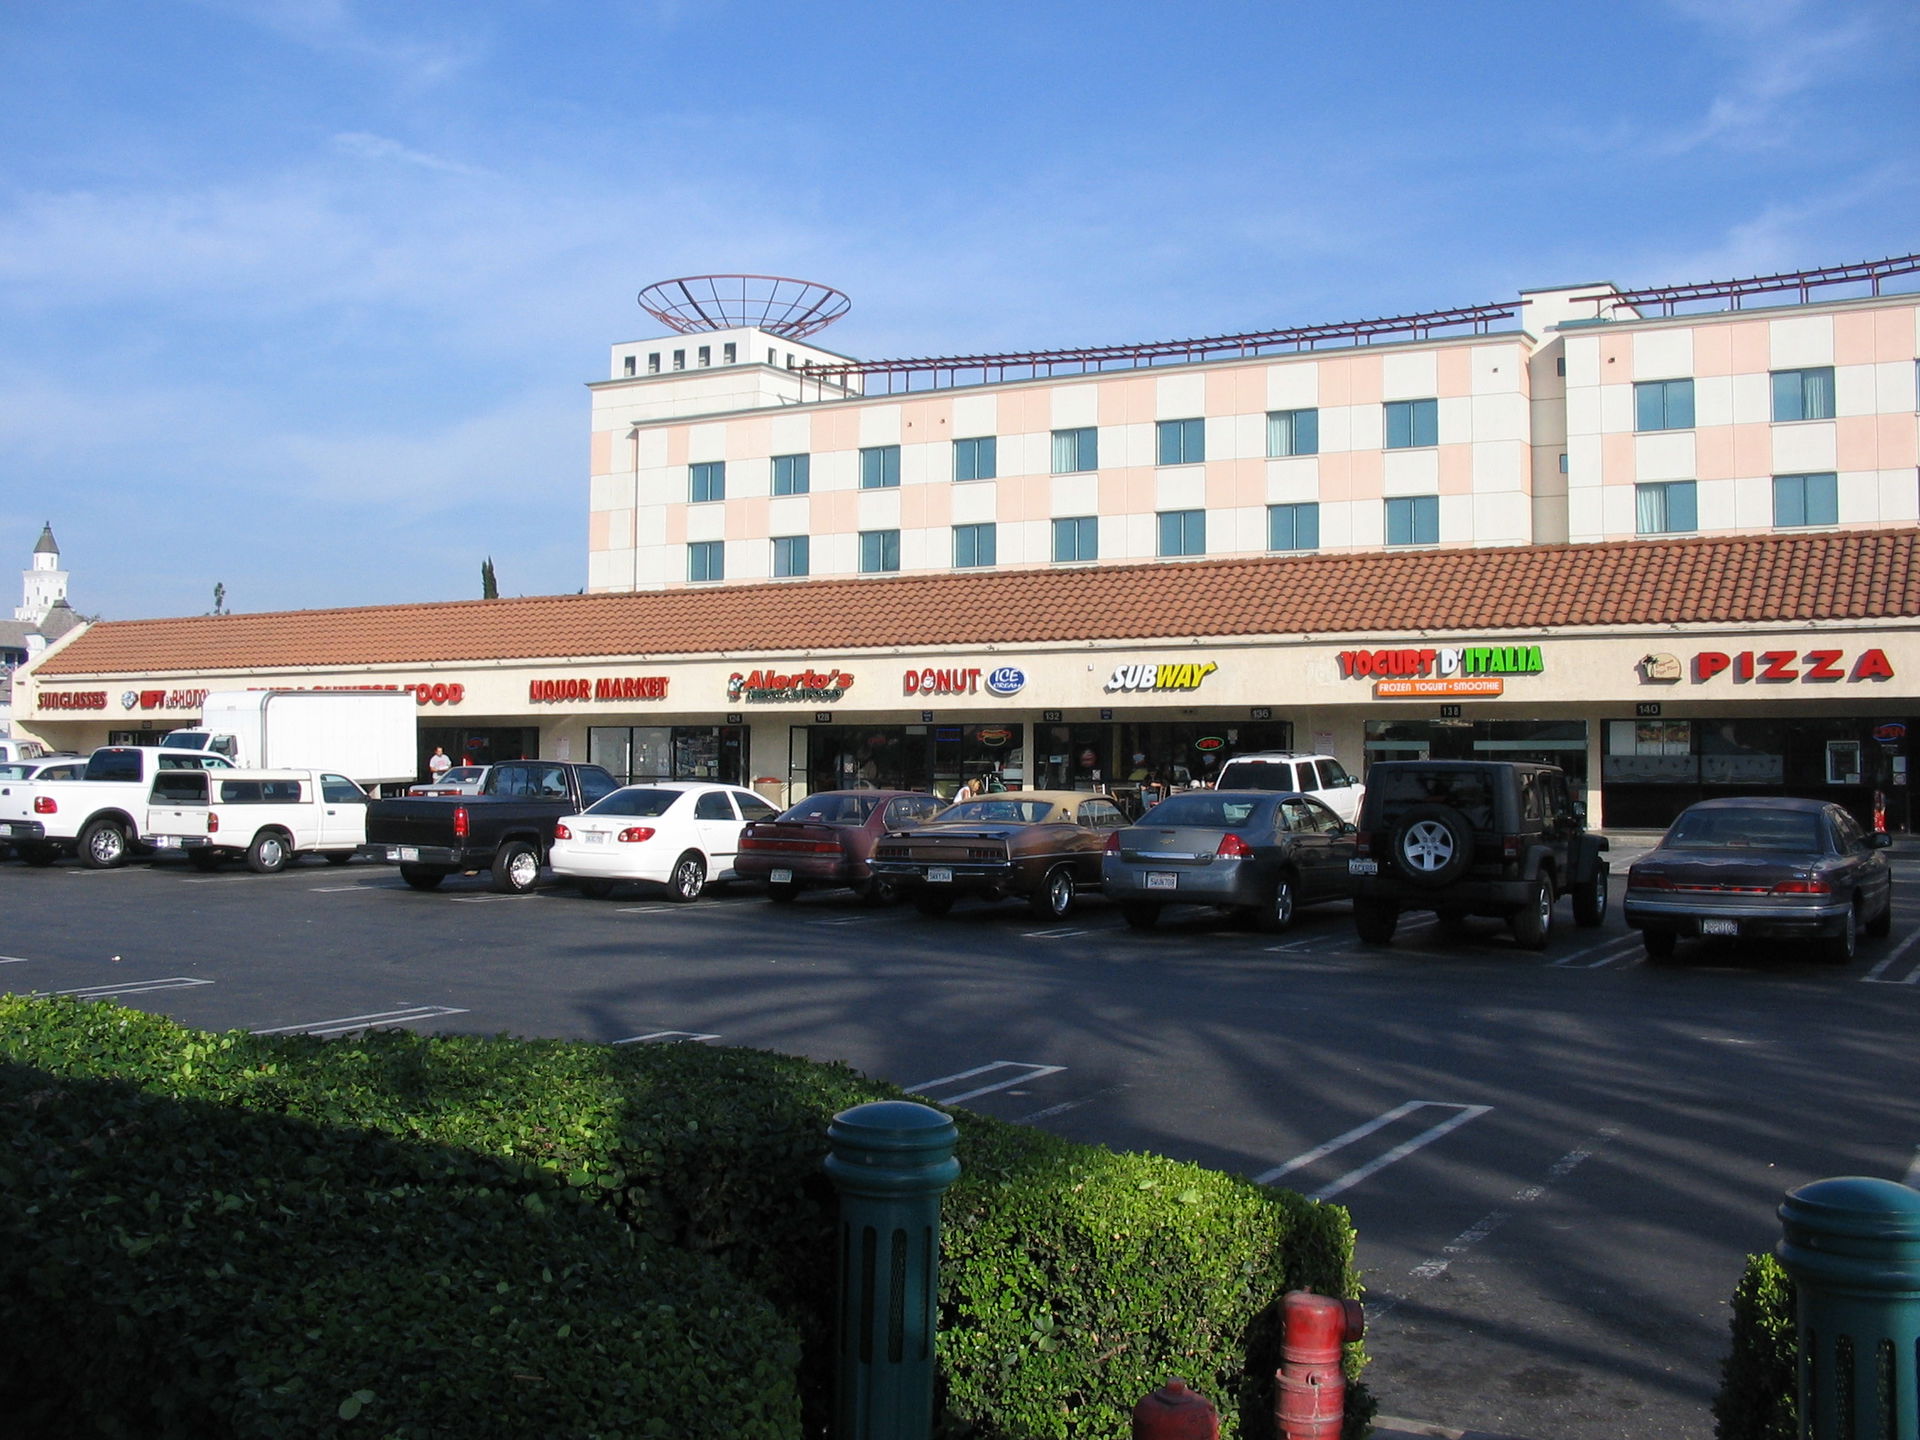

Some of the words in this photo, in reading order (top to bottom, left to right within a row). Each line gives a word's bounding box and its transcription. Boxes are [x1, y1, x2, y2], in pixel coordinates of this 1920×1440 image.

[1340, 650, 1436, 675] YOGURT
[1697, 649, 1894, 679] PIZZA
[743, 669, 854, 690] Alerto's
[905, 668, 981, 692] DONUT
[995, 669, 1019, 682] ICE
[1107, 661, 1218, 689] SUBWAY
[530, 679, 592, 701] LIQUOR
[594, 676, 669, 699] MARKET
[1379, 683, 1411, 692] FROZEN
[1415, 682, 1447, 691] YOGURT
[1453, 681, 1499, 691] SMOOTHIE
[38, 691, 108, 709] SUNGLASSES
[1639, 704, 1659, 714] 140
[1045, 711, 1060, 720] 132
[1253, 709, 1269, 718] 136
[1443, 707, 1459, 716] 138
